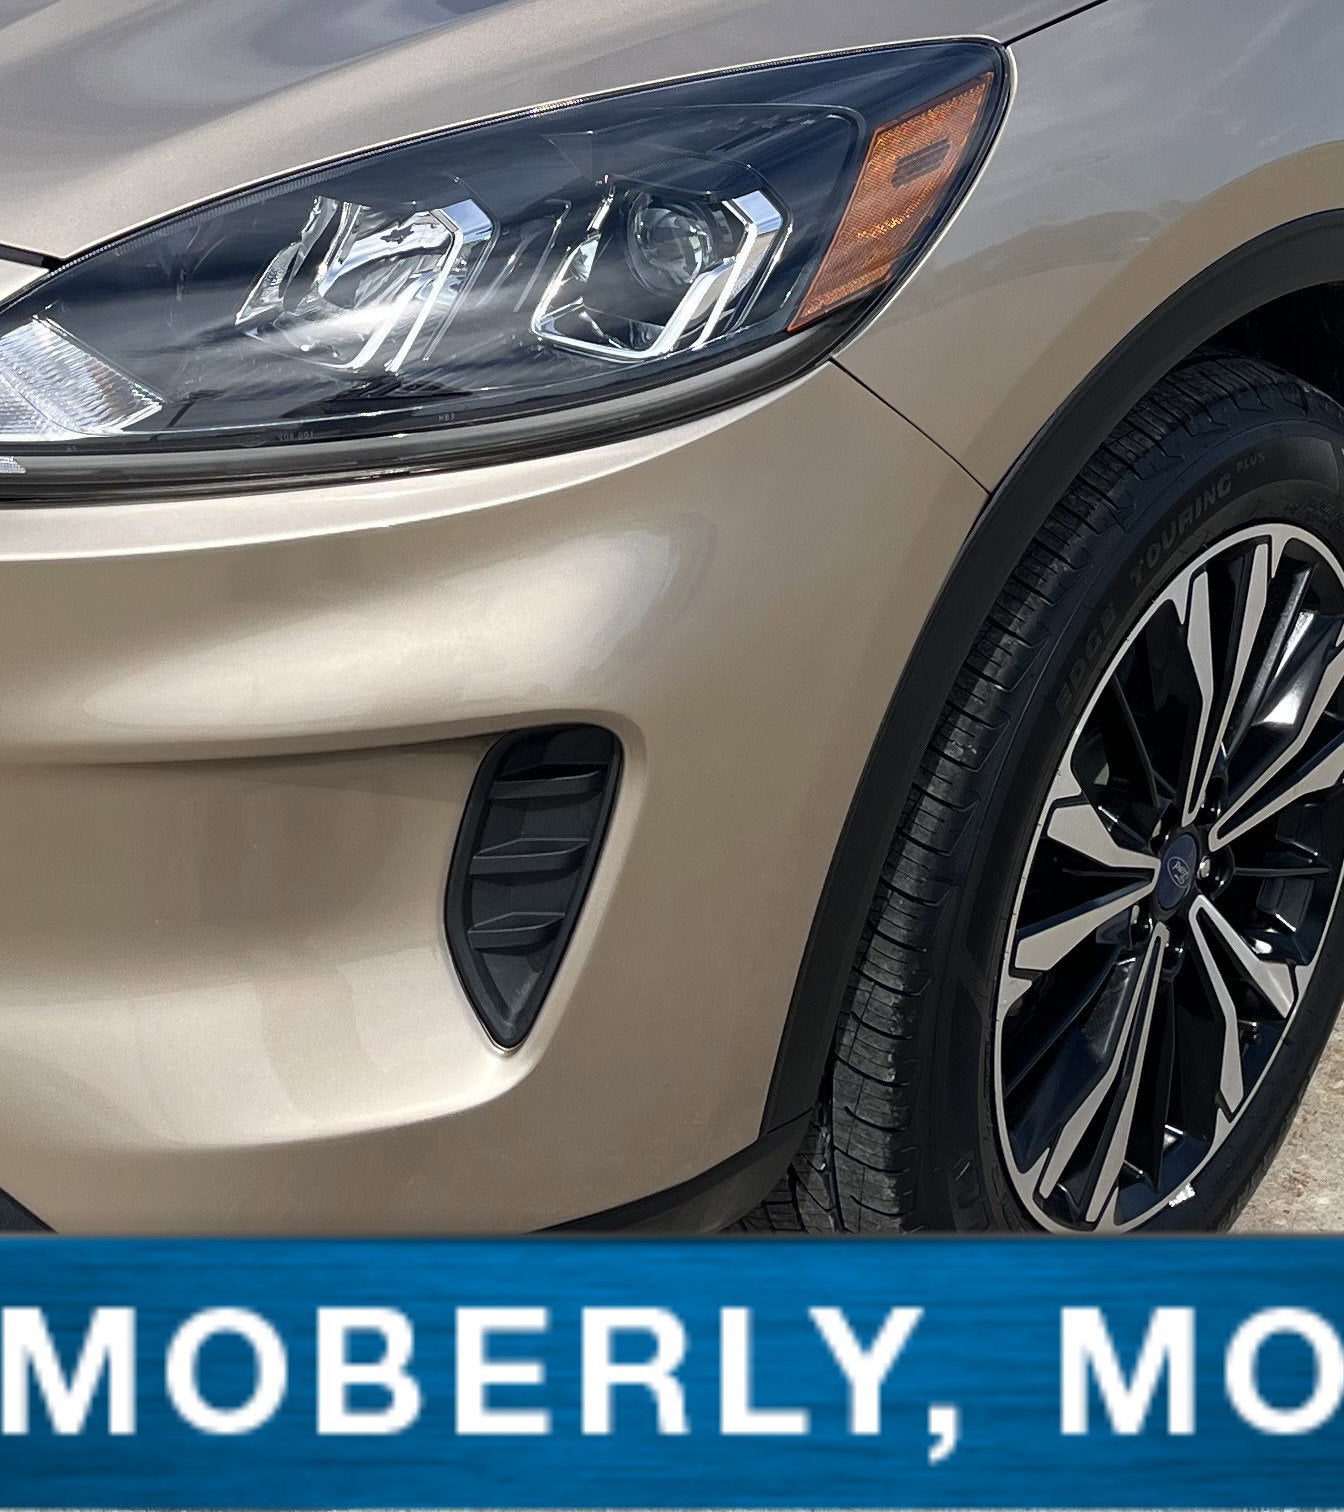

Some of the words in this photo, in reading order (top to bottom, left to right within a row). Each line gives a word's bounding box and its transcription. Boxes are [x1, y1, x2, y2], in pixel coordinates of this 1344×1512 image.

[1054, 601, 1119, 716] EDGE
[1128, 473, 1233, 588] TOURING
[1236, 451, 1267, 472] PLUS
